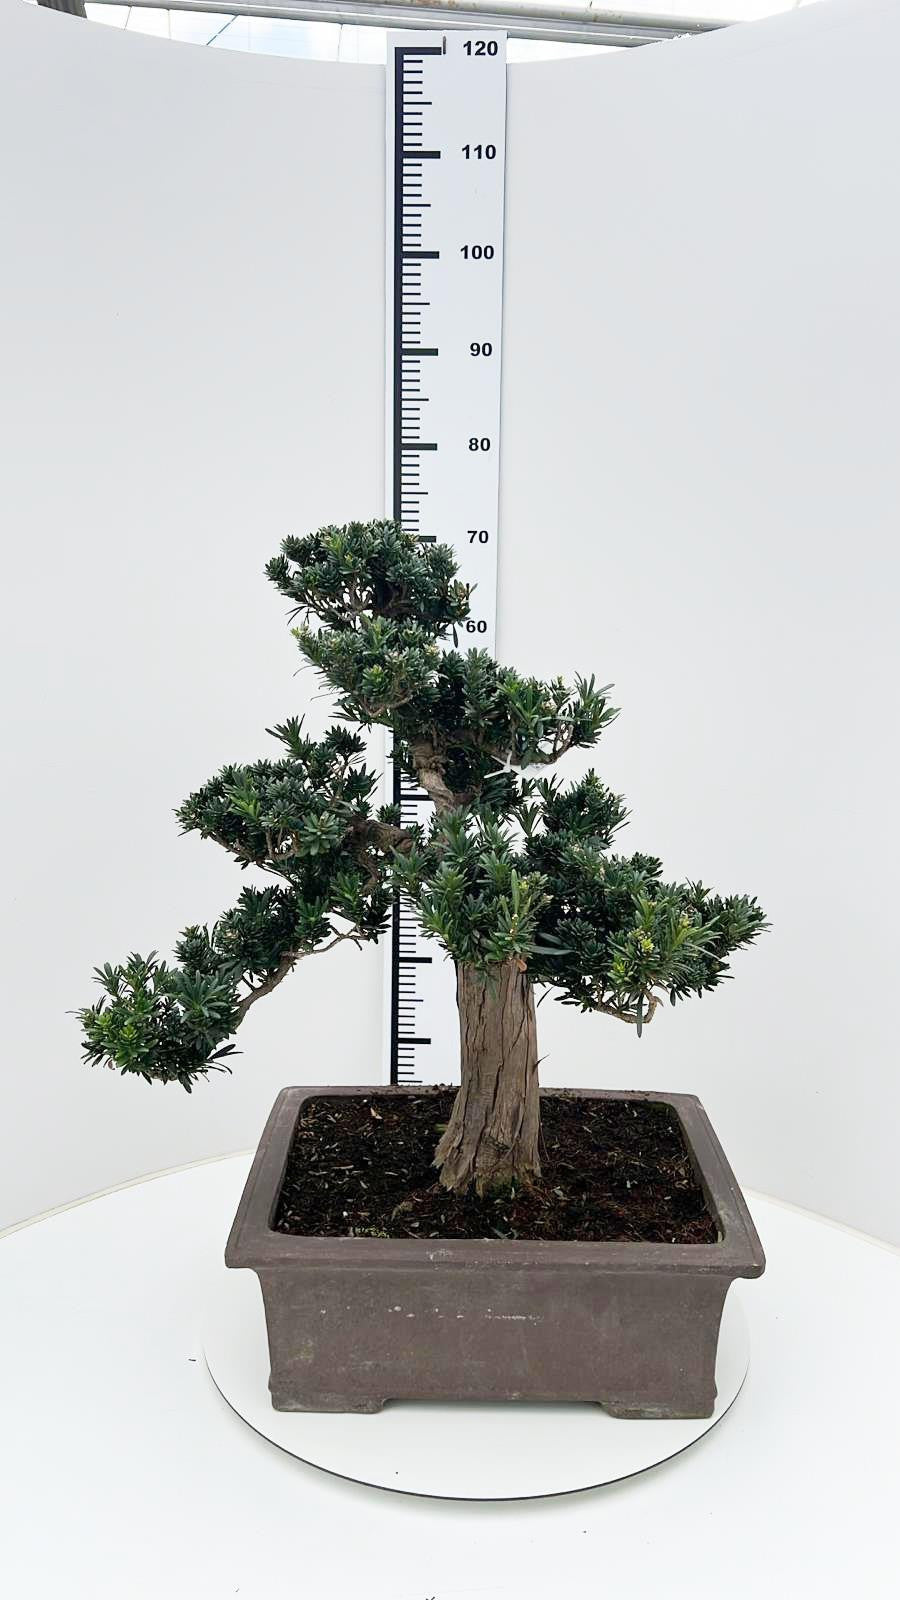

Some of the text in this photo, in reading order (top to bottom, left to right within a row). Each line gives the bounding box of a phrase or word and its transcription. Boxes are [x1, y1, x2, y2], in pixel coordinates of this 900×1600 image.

[463, 40, 499, 57] 120
[461, 144, 497, 160] 110
[460, 245, 495, 260] 100
[469, 342, 493, 357] 90
[468, 437, 491, 452] 80
[467, 530, 489, 544] 70
[466, 620, 487, 633] 60
